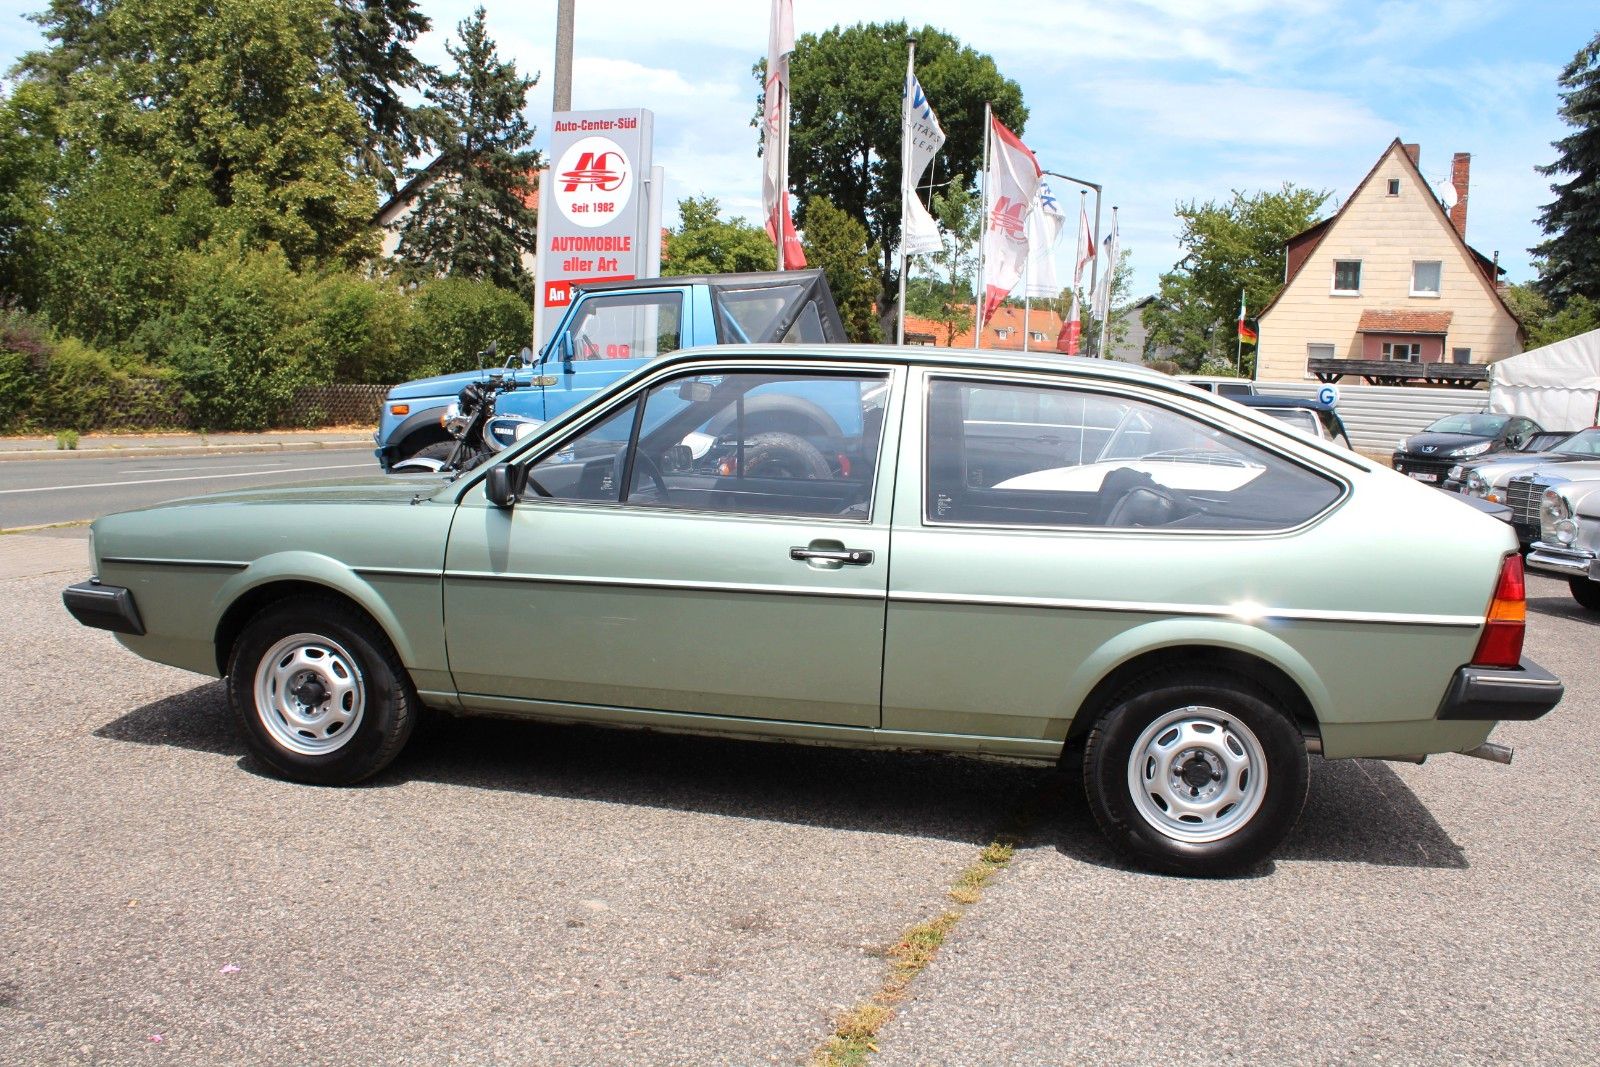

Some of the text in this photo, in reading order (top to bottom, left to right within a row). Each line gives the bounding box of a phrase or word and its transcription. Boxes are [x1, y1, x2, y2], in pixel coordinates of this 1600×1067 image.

[555, 117, 637, 132] Auto-Center-Süd
[571, 202, 615, 213] Seit 1982
[551, 236, 631, 252] AUTOMOBILE
[563, 256, 618, 272] aller Art
[548, 287, 565, 302] An
[1319, 387, 1335, 405] G
